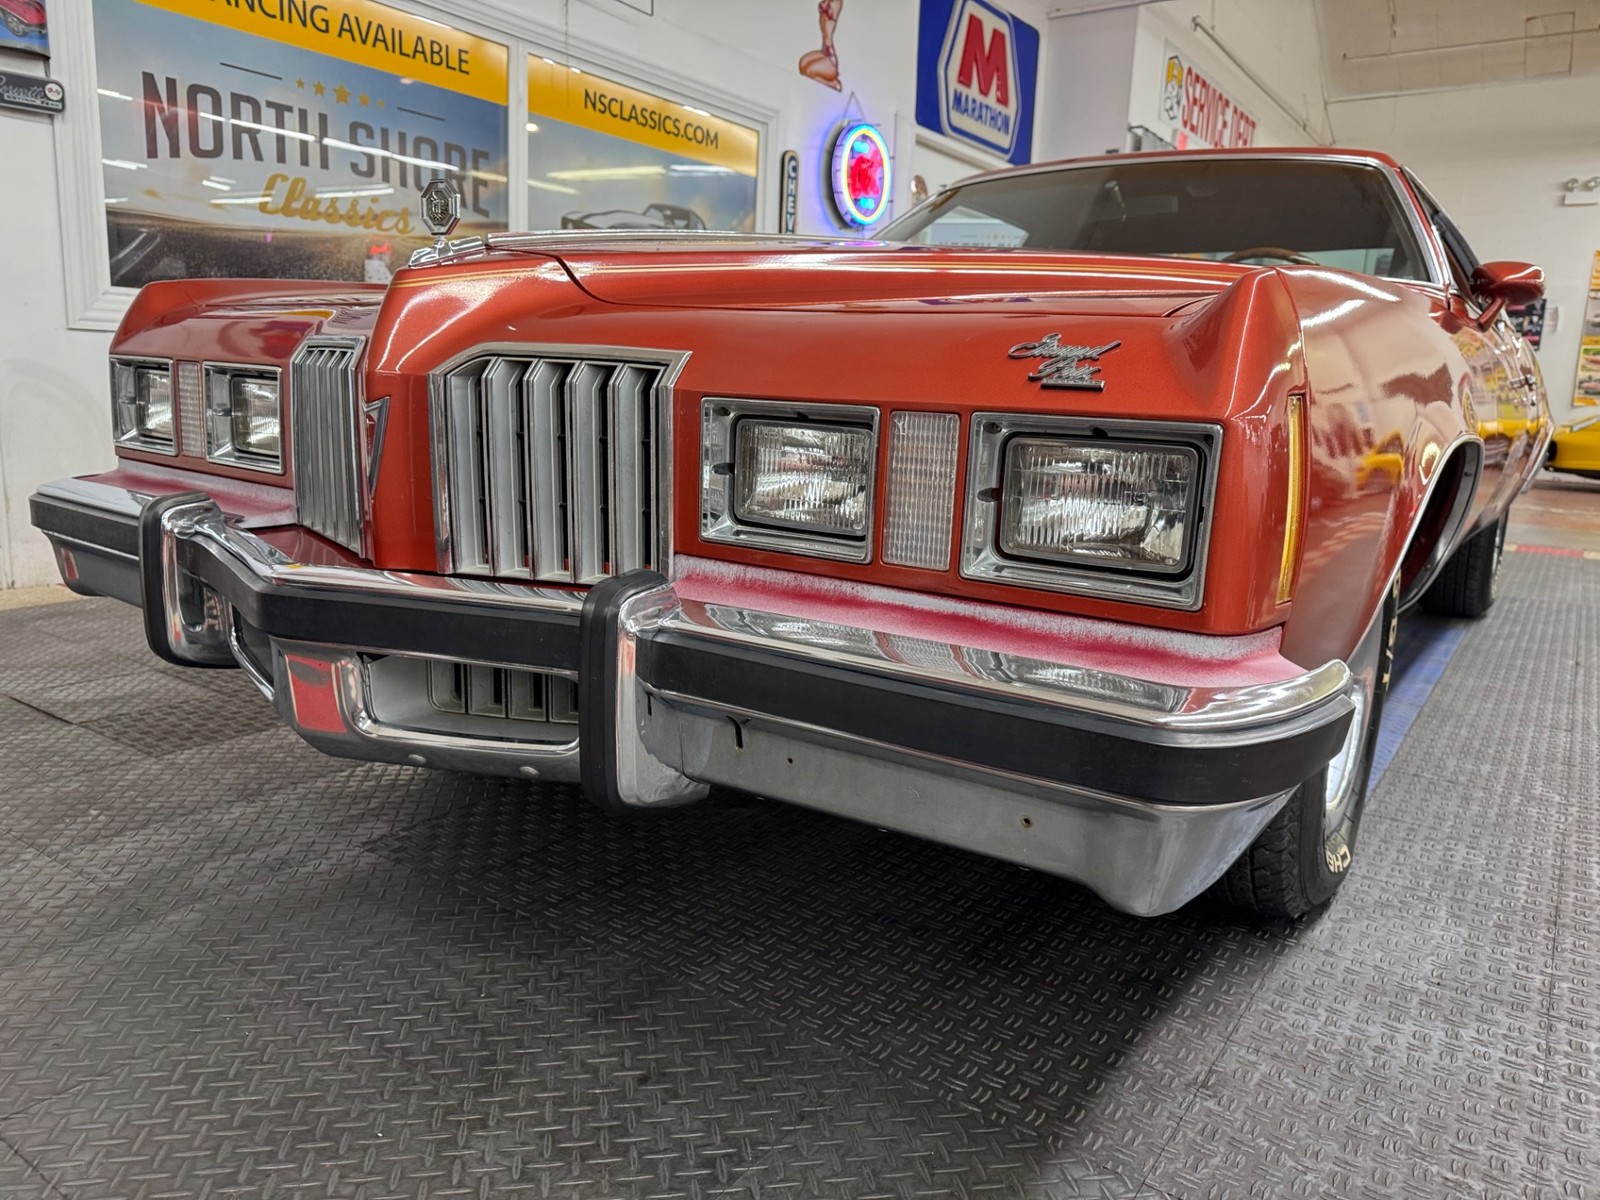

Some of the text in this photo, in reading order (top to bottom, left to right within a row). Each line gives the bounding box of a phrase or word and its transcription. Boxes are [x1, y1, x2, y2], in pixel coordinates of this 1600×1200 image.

[337, 12, 470, 75] AVAILABLE
[957, 12, 1009, 108] M
[584, 88, 719, 150] NSCLASSICS.COM
[952, 88, 1010, 136] MARATHON
[1182, 66, 1230, 148] SERVICE
[142, 71, 490, 218] NORTH SHORE
[258, 173, 416, 235] Classics
[785, 160, 797, 235] CHEV
